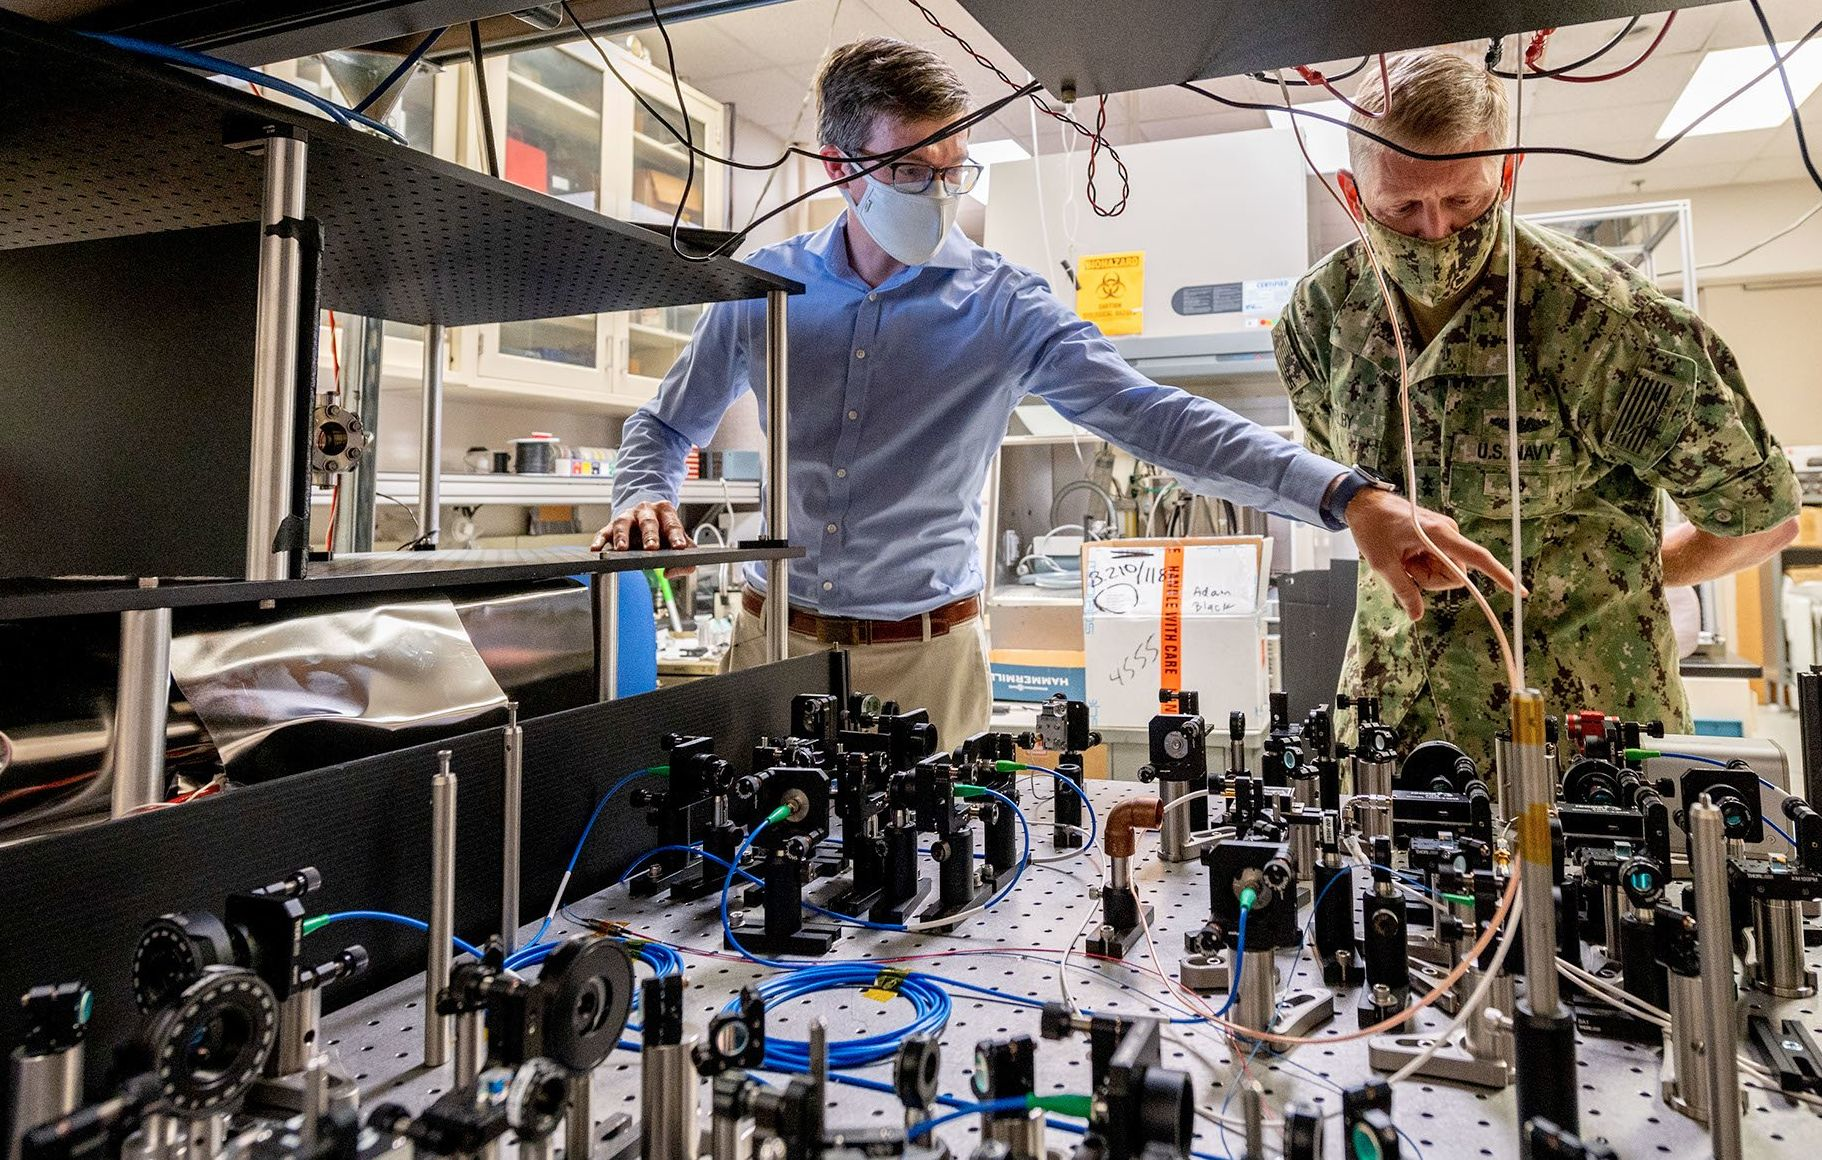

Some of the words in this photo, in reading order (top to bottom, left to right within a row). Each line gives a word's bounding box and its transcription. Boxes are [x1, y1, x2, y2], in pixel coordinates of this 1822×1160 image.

[1477, 442, 1507, 460] U.S.
[1194, 586, 1231, 597] Adam
[1192, 601, 1236, 613] Black
[1164, 612, 1179, 642] WITH
[1164, 645, 1178, 675] CARE
